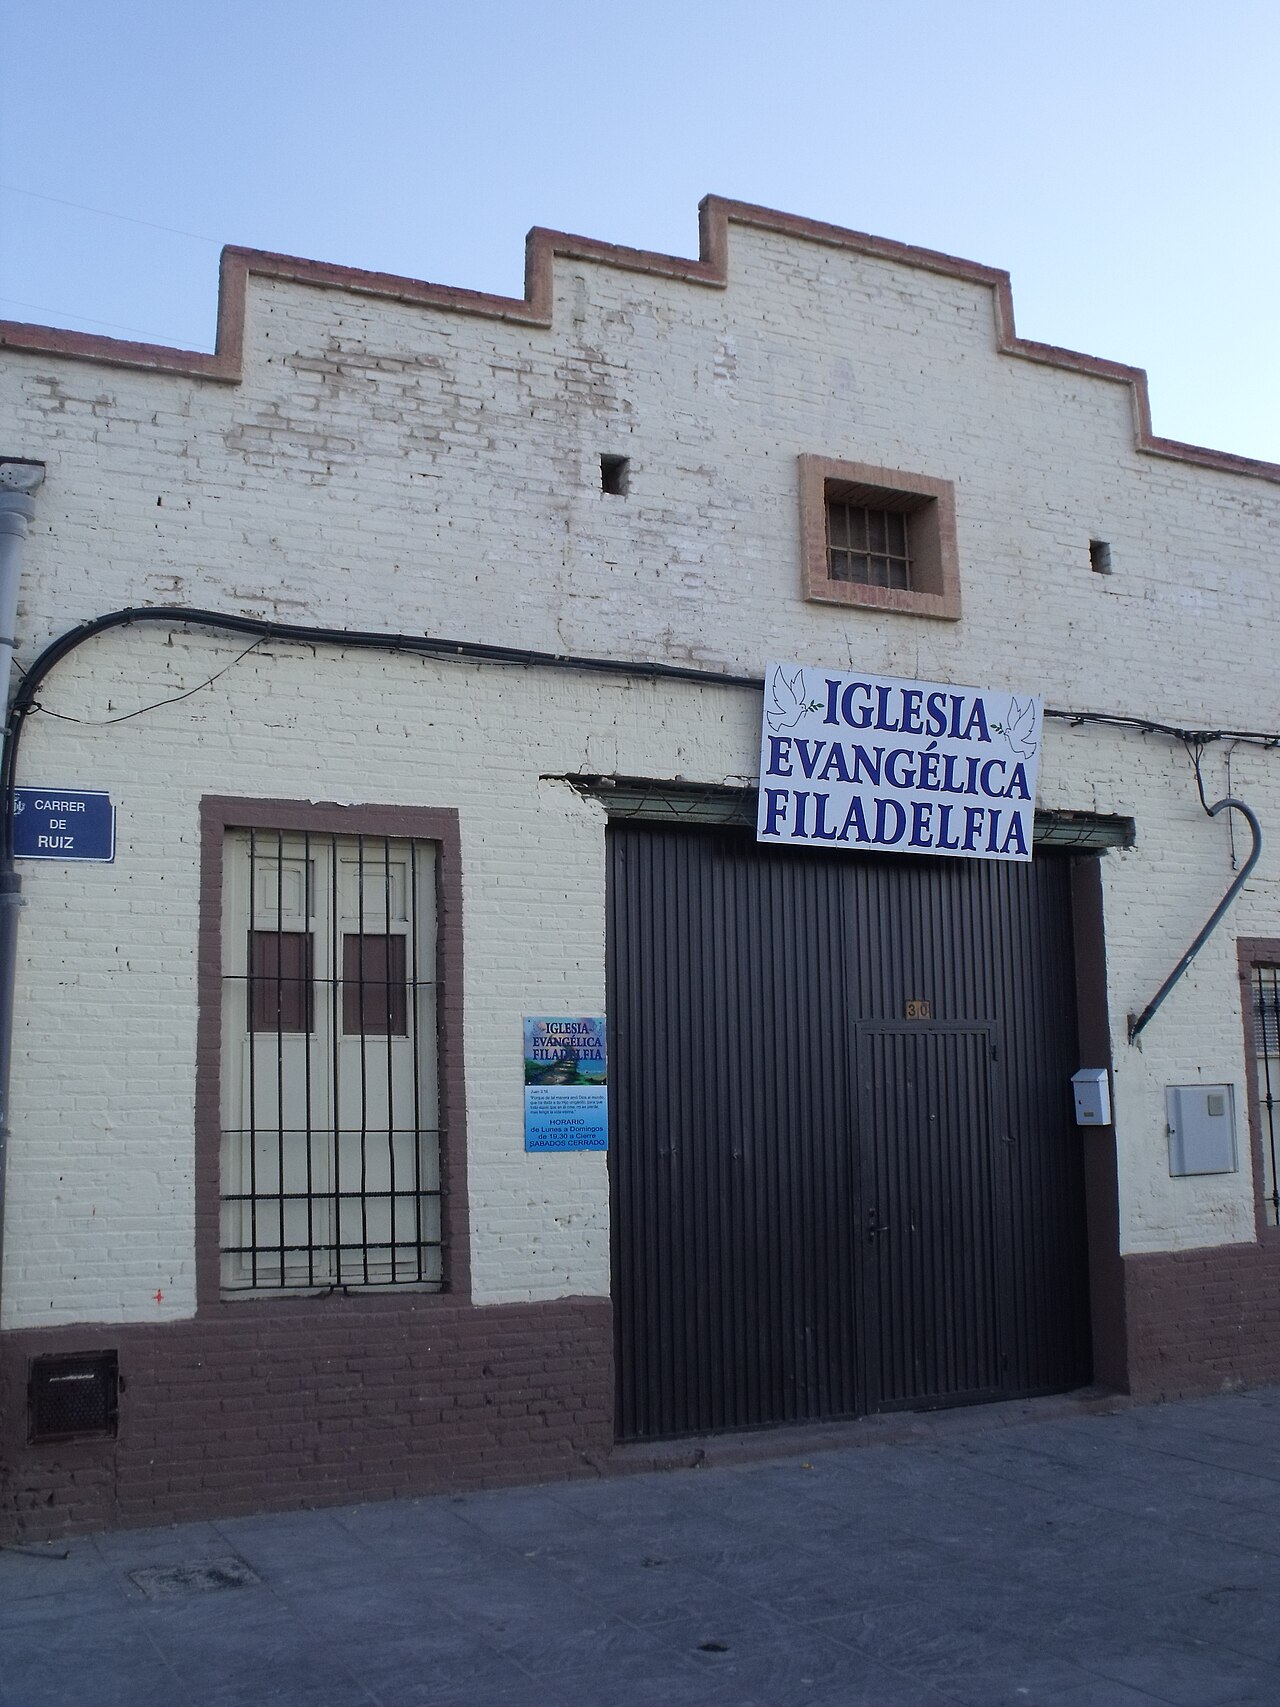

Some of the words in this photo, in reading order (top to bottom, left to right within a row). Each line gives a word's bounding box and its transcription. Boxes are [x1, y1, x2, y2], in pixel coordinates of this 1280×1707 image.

[823, 678, 992, 743] IGLESIA
[766, 734, 1032, 801] EVANGÉLICA
[34, 799, 86, 813] CARRER
[49, 819, 67, 830] DE
[762, 788, 1029, 856] FILADELFIA
[37, 835, 74, 849] RUIZ
[908, 1003, 928, 1017] 30
[545, 1022, 590, 1034] IGLESIA
[532, 1034, 603, 1047] EVANGÉLICA
[532, 1048, 603, 1060] FILADLFIA
